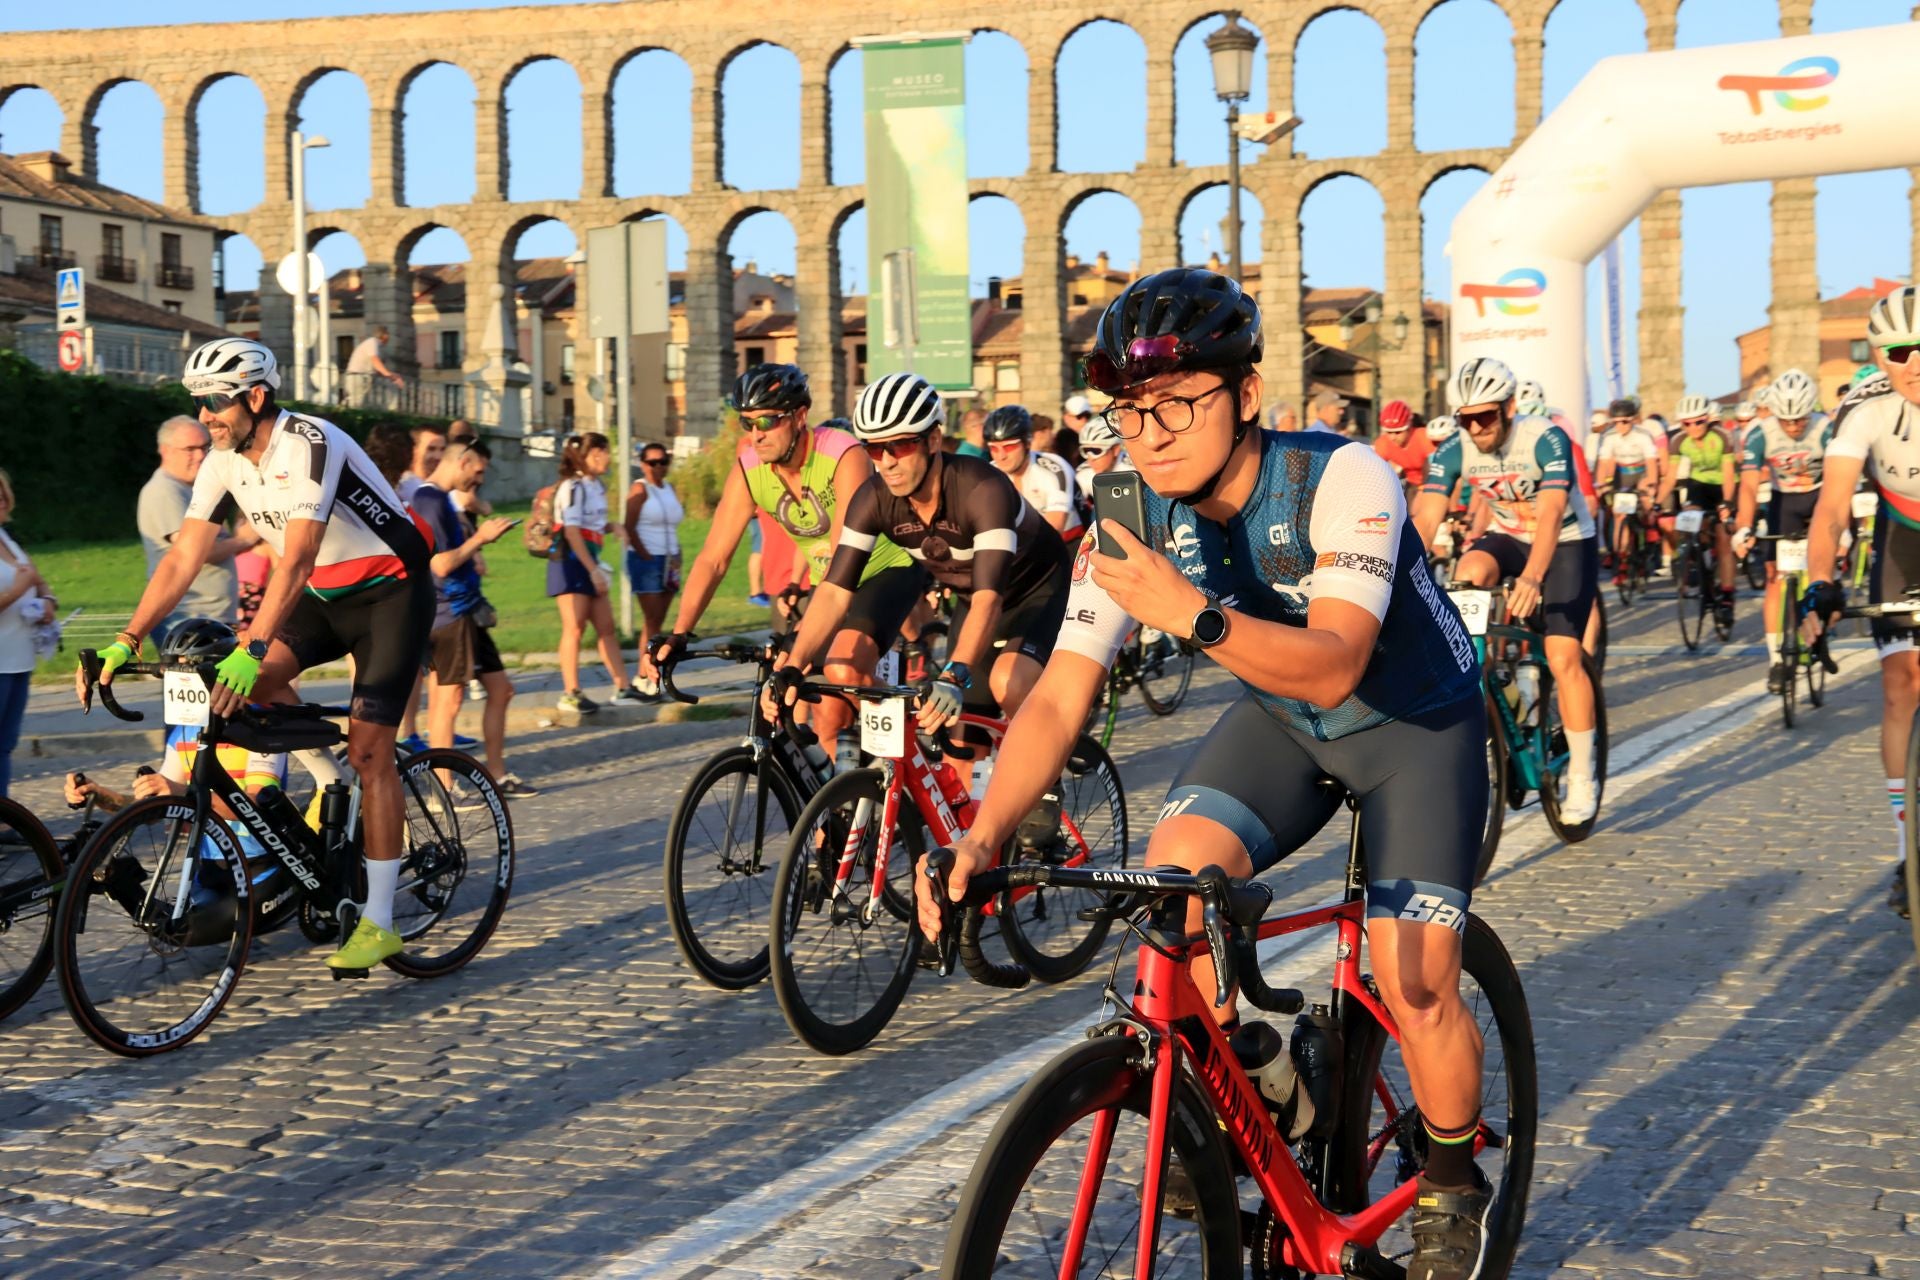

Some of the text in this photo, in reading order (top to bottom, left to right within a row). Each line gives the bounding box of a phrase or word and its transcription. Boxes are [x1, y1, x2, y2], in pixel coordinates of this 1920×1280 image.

[1717, 124, 1843, 145] TotalEnergies
[292, 502, 322, 512] LPRC
[348, 488, 391, 526] LPRC
[1335, 560, 1357, 570] DE
[168, 688, 207, 704] 1400
[1092, 871, 1160, 887] CANYON
[1206, 1046, 1273, 1174] CANYON
